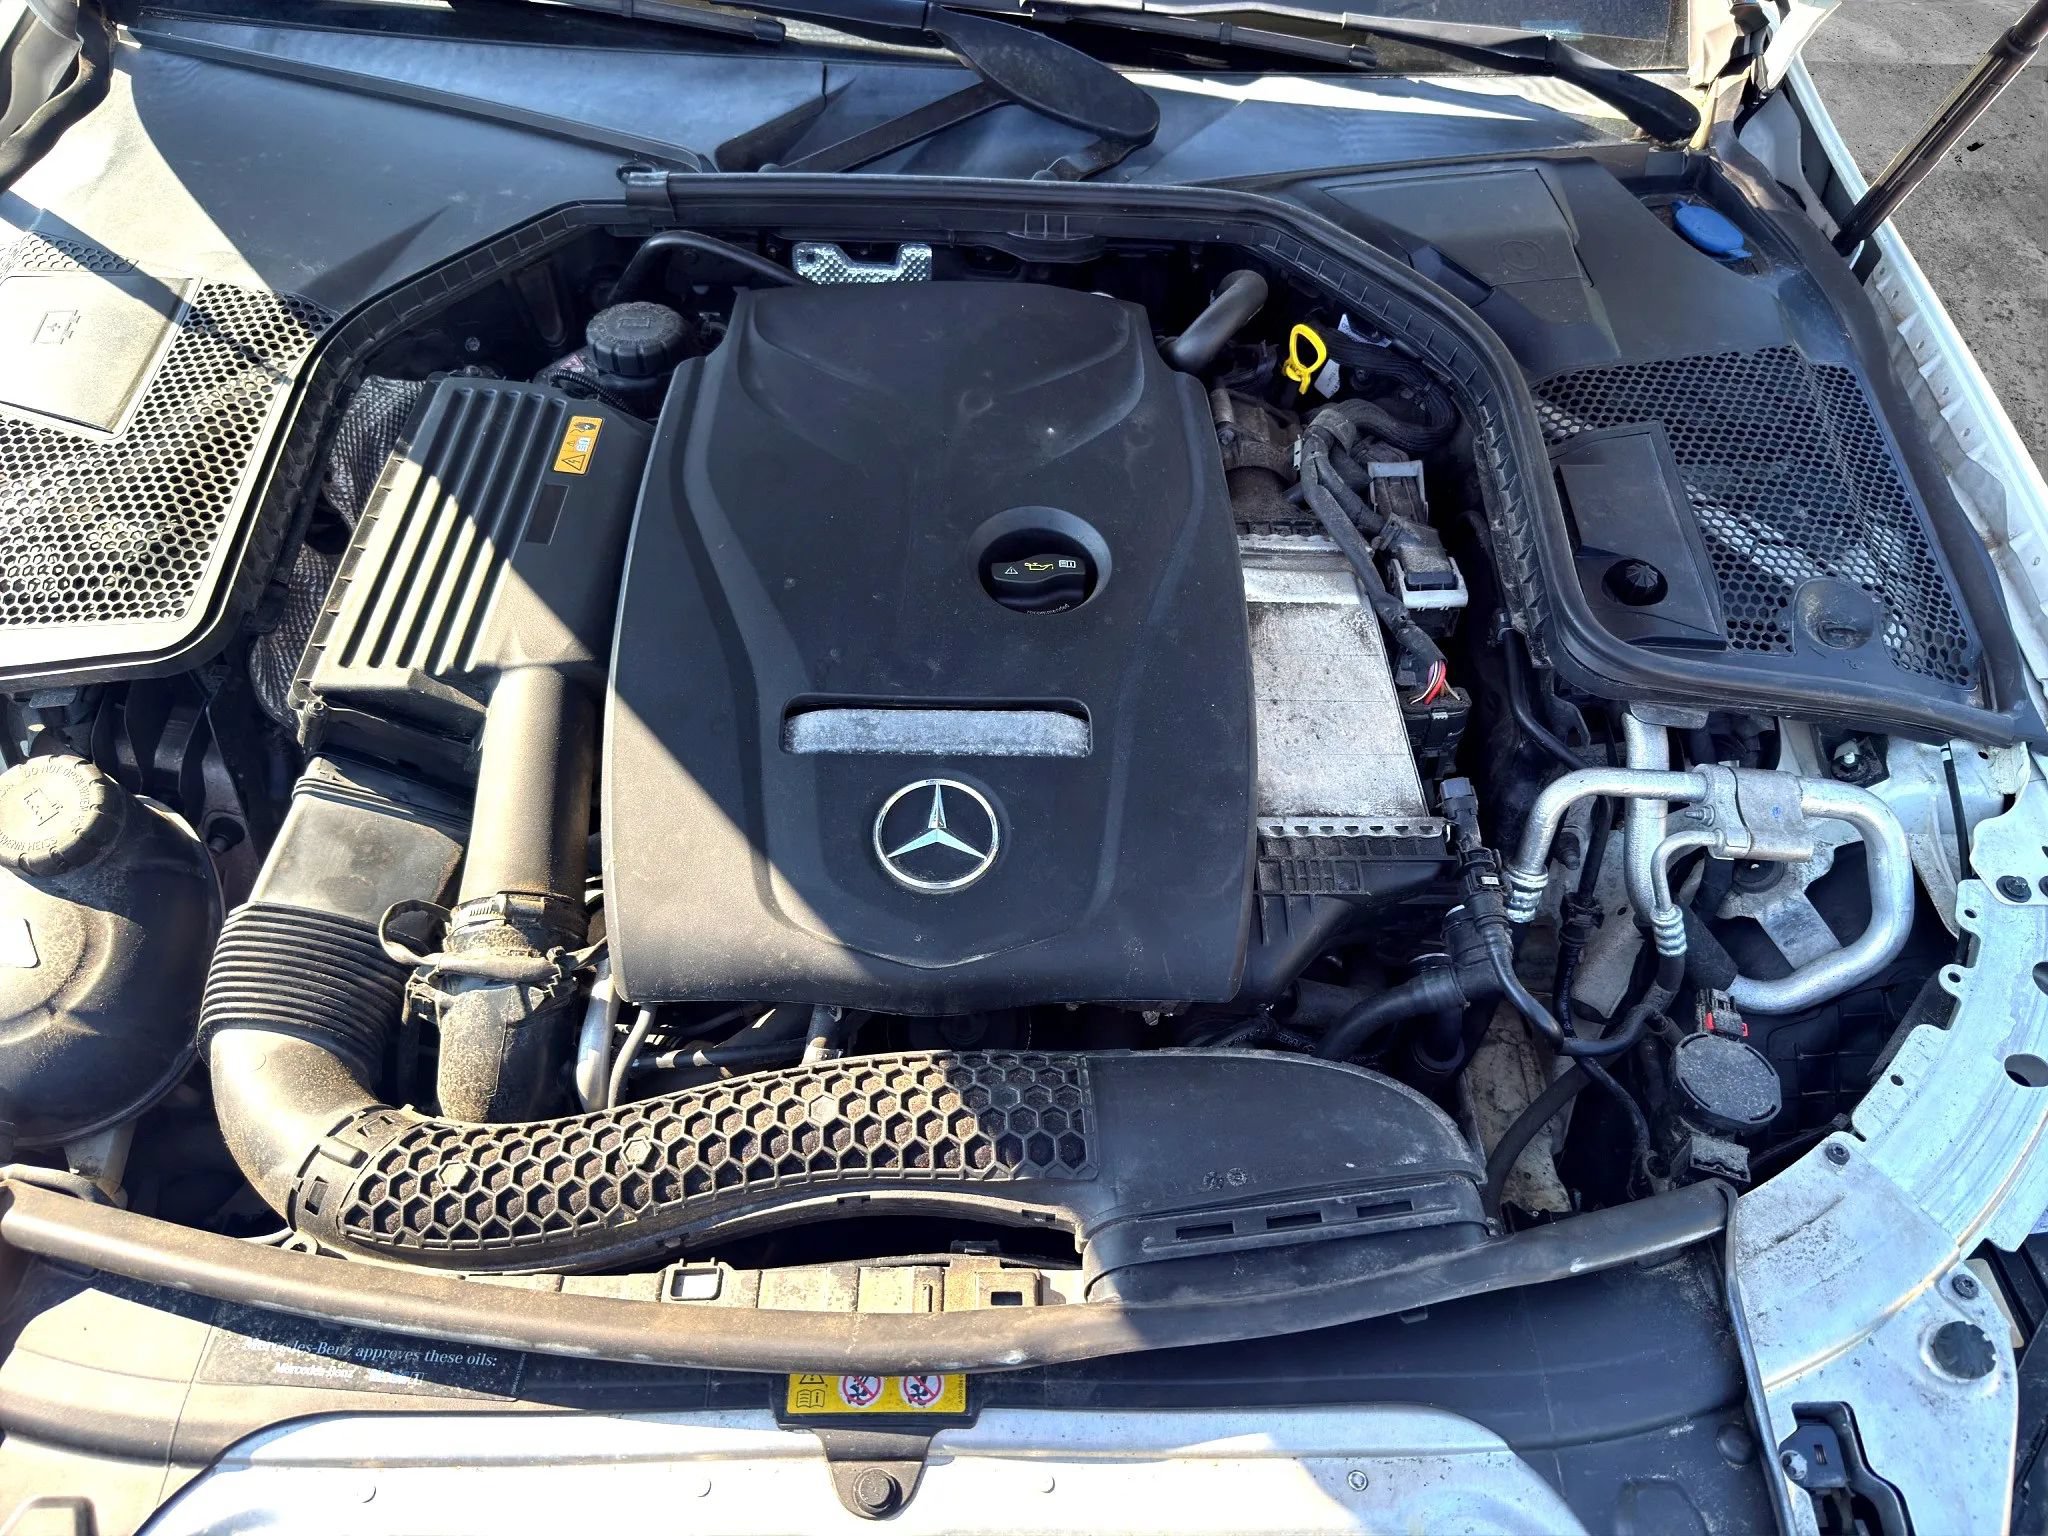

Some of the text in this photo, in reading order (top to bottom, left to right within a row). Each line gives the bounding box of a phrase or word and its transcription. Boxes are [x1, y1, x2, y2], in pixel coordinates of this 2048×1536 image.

[355, 1346, 422, 1364] approves
[424, 1350, 463, 1364] these
[467, 1353, 498, 1367] oils:
